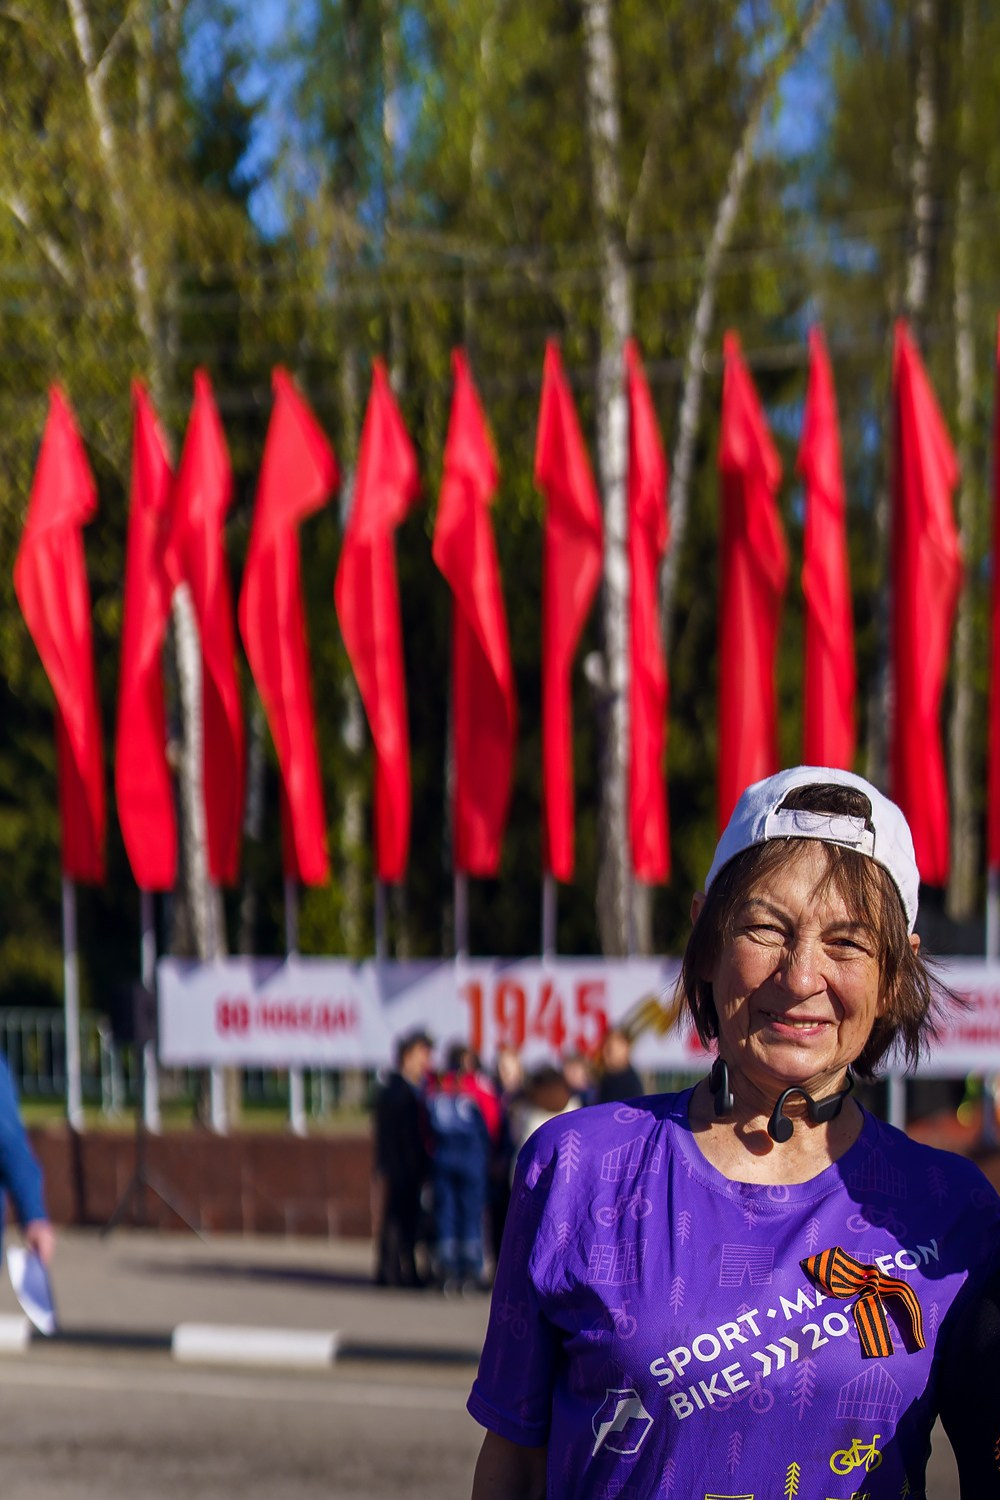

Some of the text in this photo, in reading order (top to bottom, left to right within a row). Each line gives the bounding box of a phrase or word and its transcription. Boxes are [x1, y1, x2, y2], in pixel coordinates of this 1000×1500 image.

[460, 976, 610, 1062] 1945
[649, 1239, 940, 1387] SPORT MAFON
[668, 1301, 888, 1421] BIKE 20
